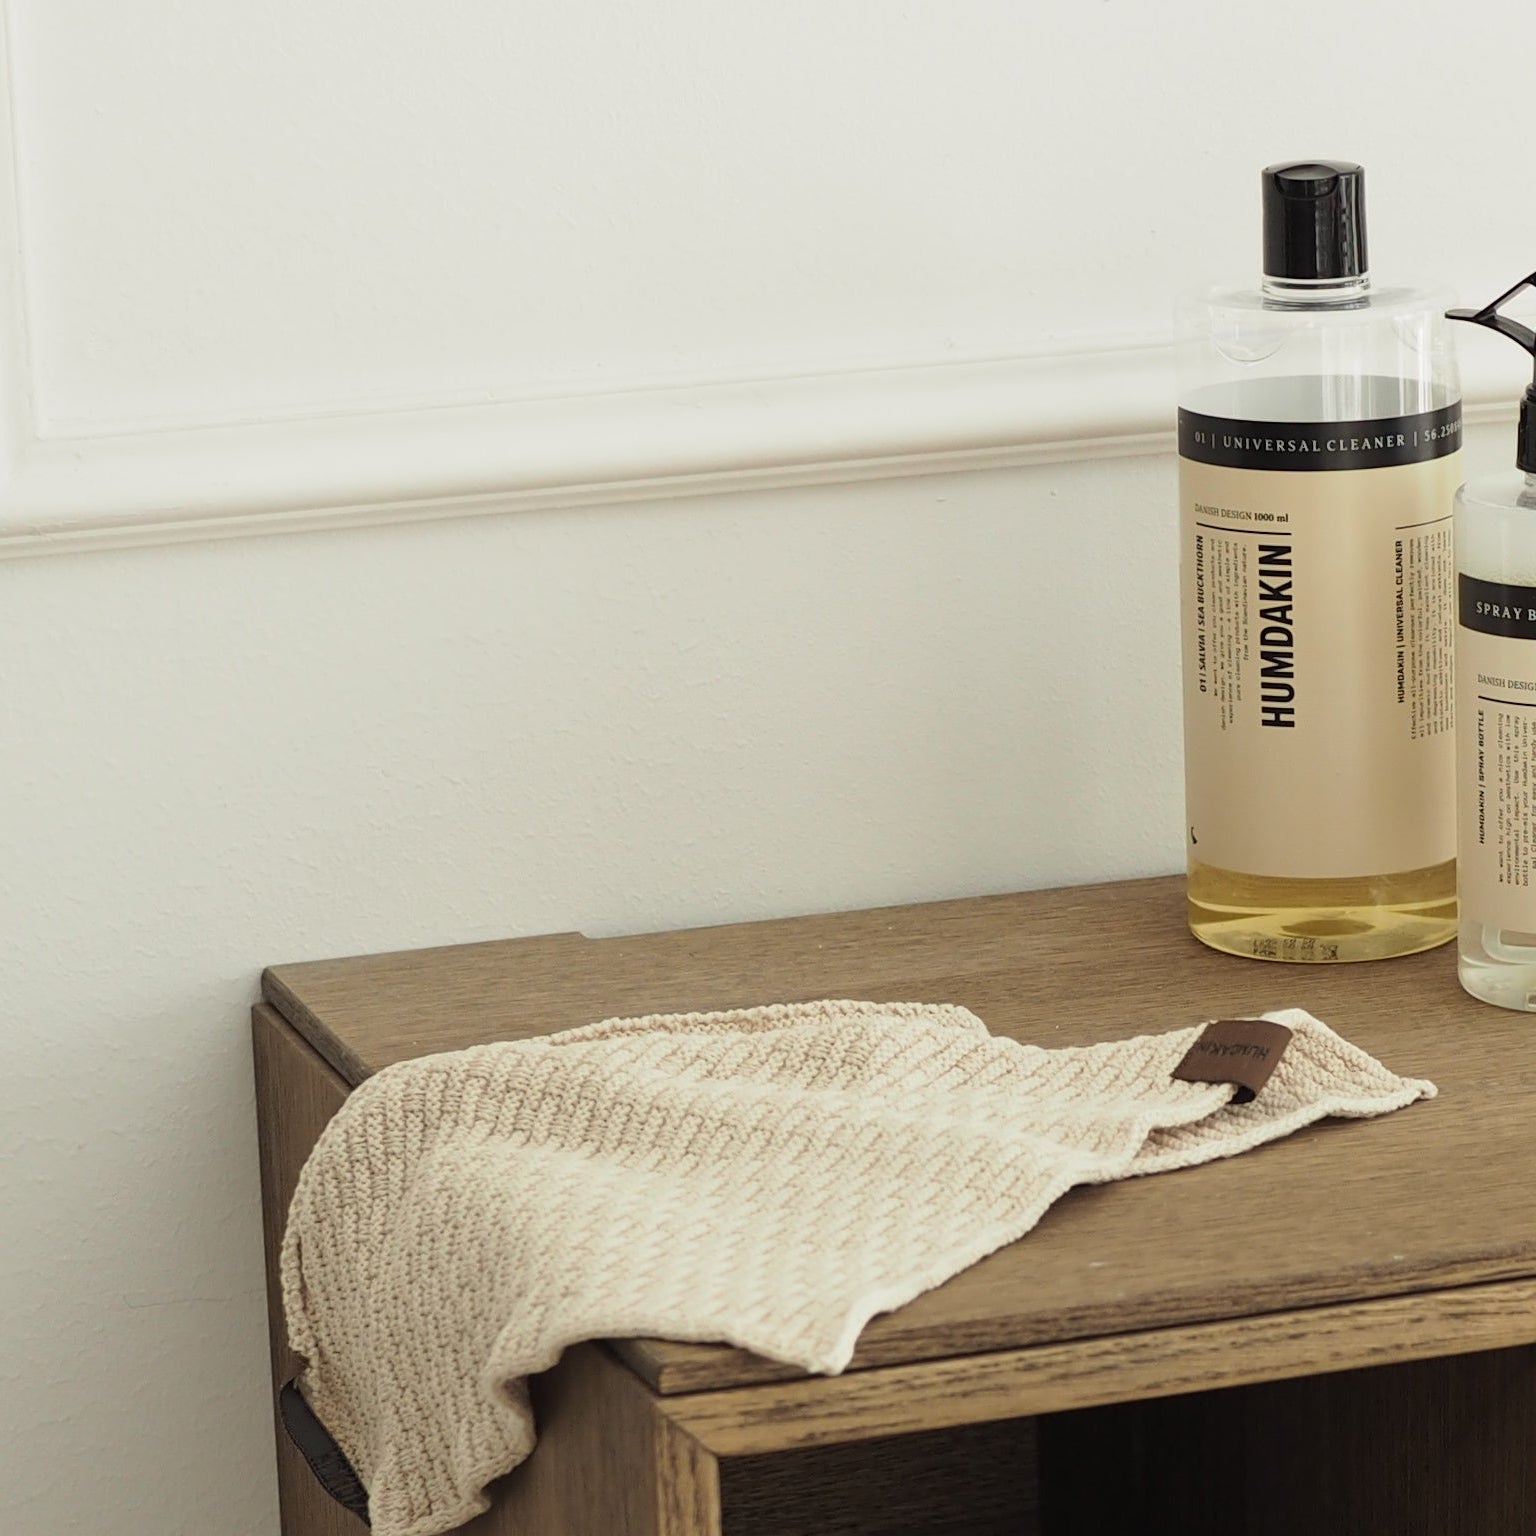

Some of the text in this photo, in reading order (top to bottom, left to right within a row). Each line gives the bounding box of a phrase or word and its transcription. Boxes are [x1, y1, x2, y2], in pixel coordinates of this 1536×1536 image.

[1222, 435, 1321, 453] UNIVERSAL
[1326, 433, 1406, 452] CLEANER
[1220, 508, 1253, 521] DESIGN
[1253, 512, 1275, 522] 1000
[1276, 512, 1290, 523] ml
[1395, 540, 1404, 586] CLEANER
[1197, 606, 1205, 627] SEA
[1396, 586, 1405, 643] UNIVERSAL
[1475, 600, 1523, 620] SPRAY
[1197, 634, 1206, 672] SALVIA
[1258, 544, 1295, 728] HUMDAKIN
[1397, 651, 1405, 704] HUMDAKIN
[1477, 674, 1506, 688] DANISH
[1477, 710, 1485, 747] BOTTLE
[1477, 750, 1485, 782] SPRAY
